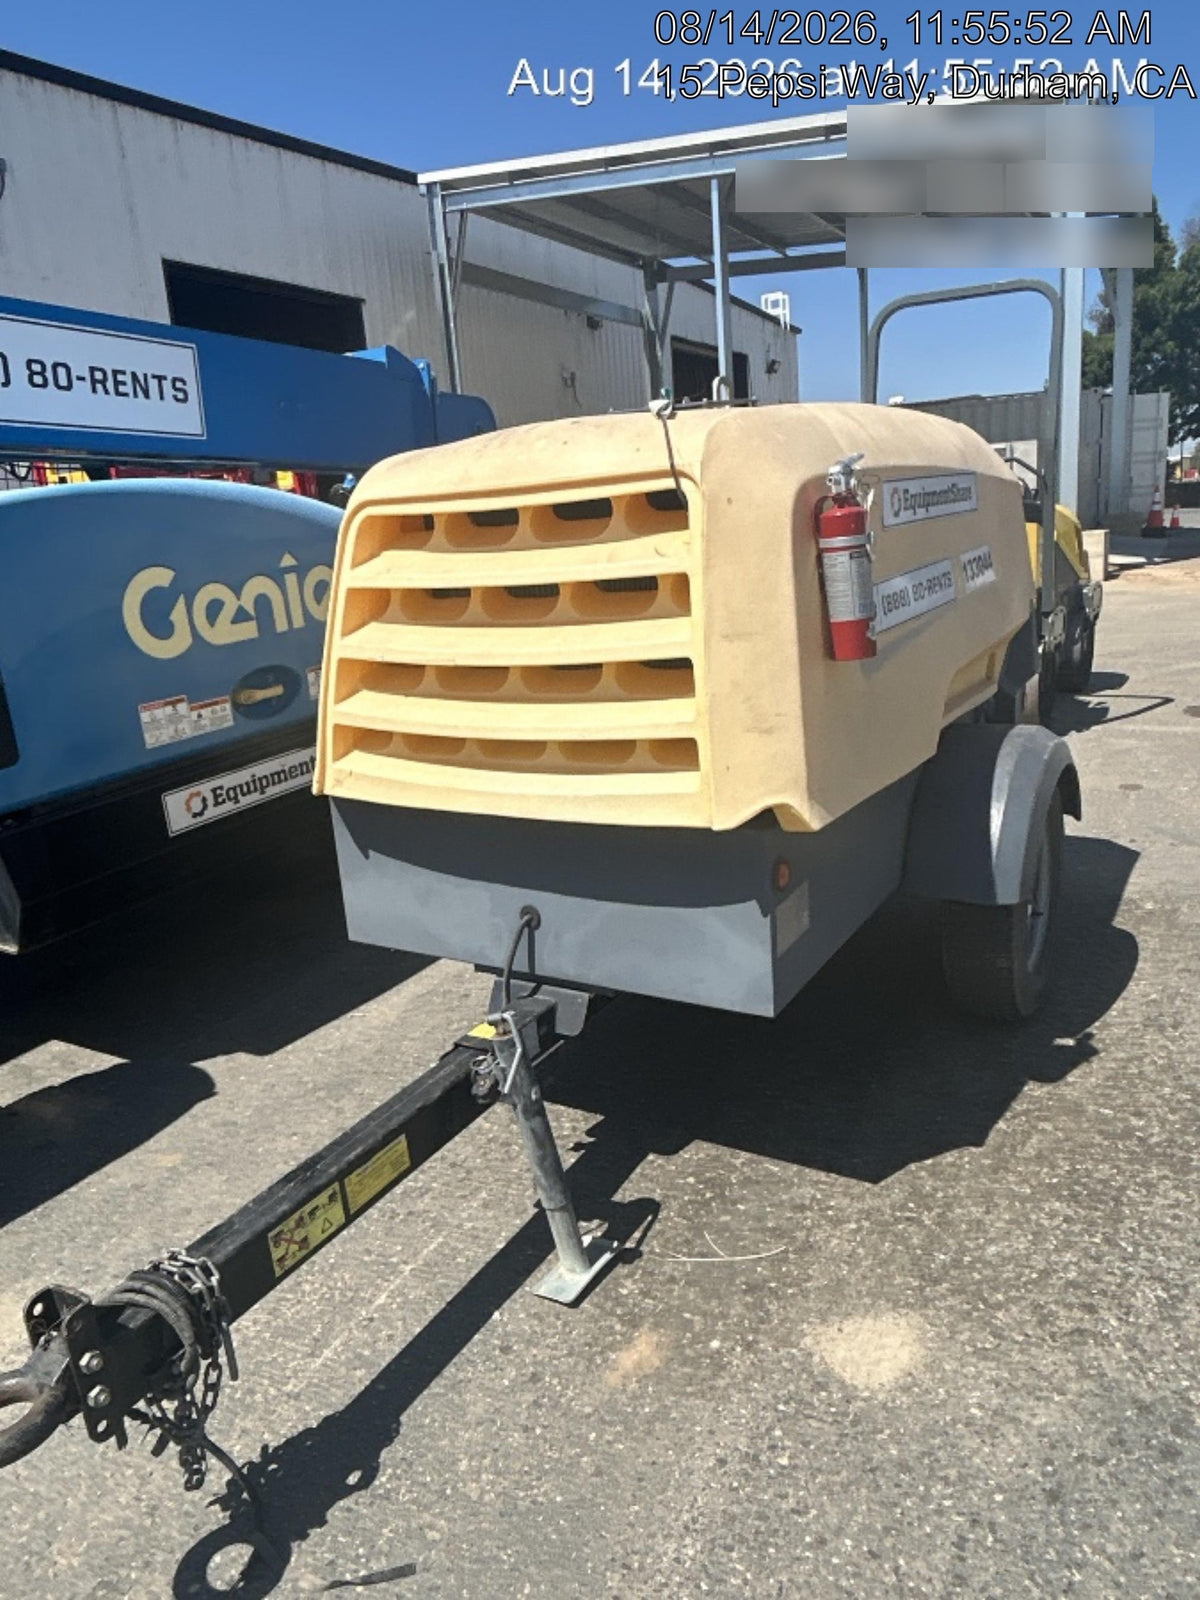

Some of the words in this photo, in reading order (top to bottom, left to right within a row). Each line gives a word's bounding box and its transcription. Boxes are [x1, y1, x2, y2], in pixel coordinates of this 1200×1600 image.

[26, 358, 189, 405] 80-RENTS
[902, 483, 973, 516] EquipmentShare
[911, 571, 953, 603] 80-RENTS
